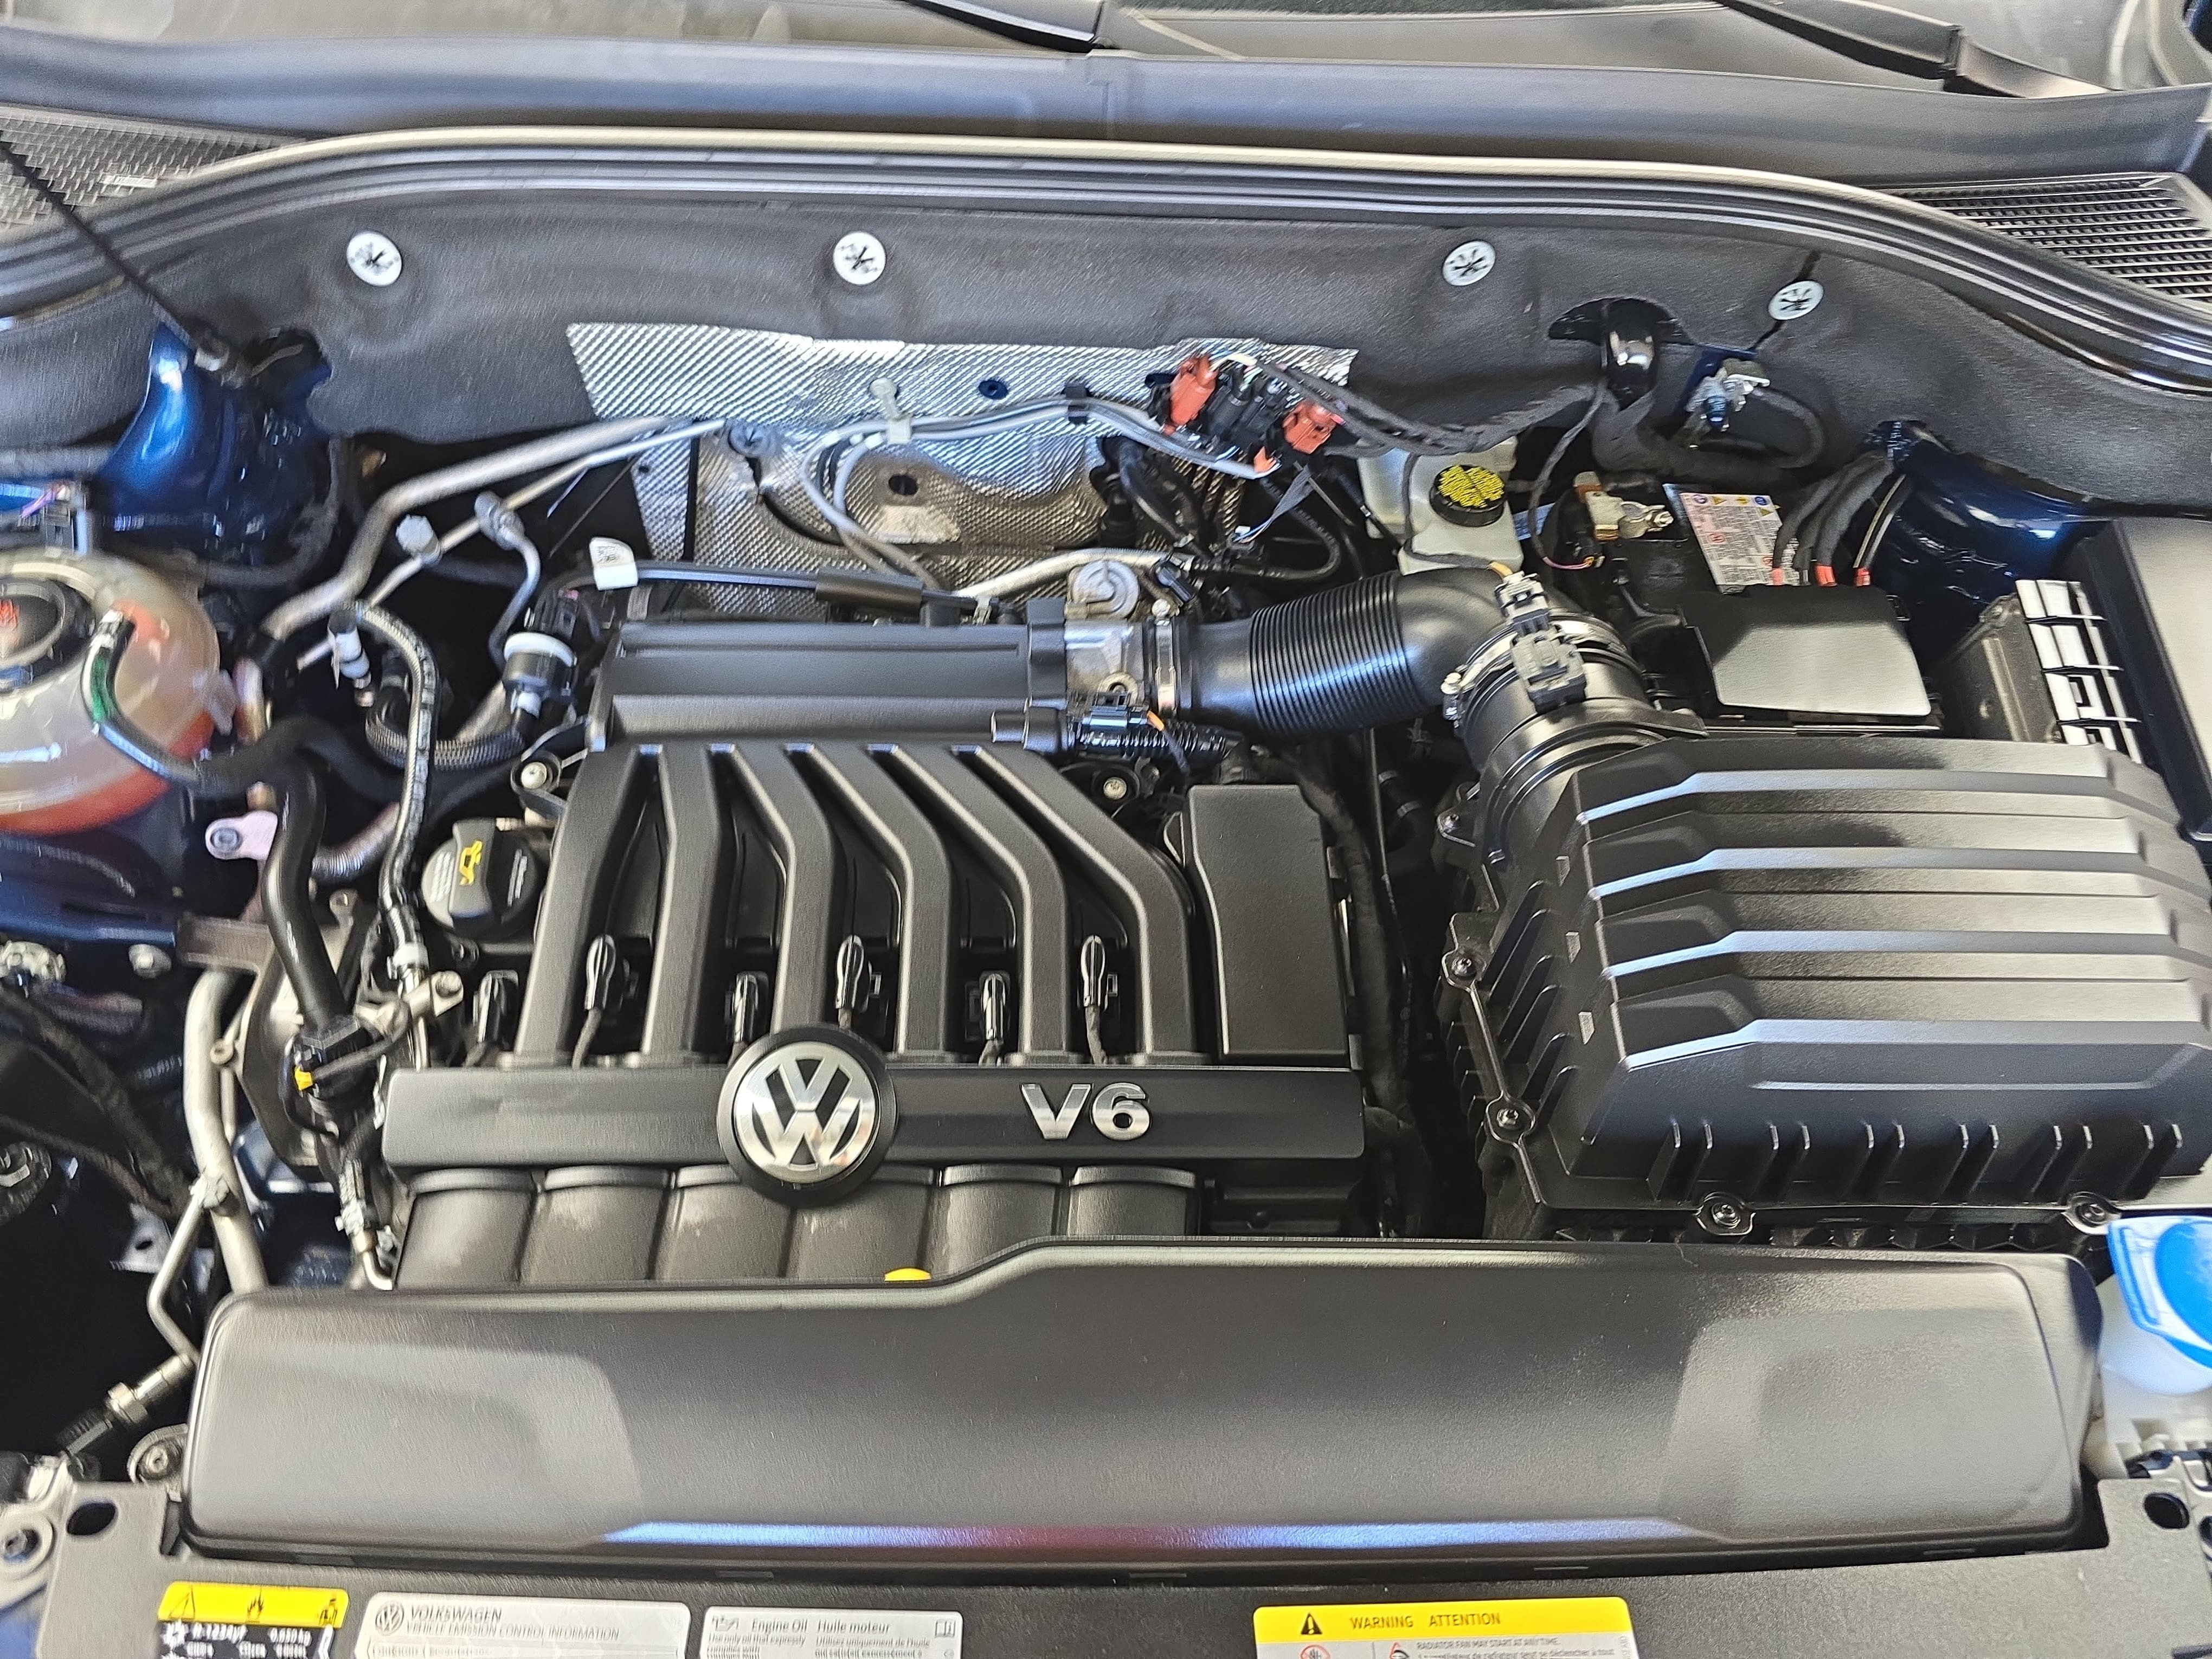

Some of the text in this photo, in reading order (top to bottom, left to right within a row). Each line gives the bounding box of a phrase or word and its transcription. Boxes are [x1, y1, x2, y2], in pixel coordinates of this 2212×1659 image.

[1020, 1083, 1151, 1140] V6
[410, 1604, 502, 1623] VOLKSWAGEN
[1350, 1612, 1501, 1629] WARNING ATTENTION
[448, 1623, 497, 1637] EMISSION
[500, 1624, 544, 1638] CONTROL
[548, 1625, 621, 1641] INFORMATION
[752, 1617, 808, 1635] Engine Oil
[818, 1619, 890, 1634] Huile moteur
[1416, 1640, 1455, 1649] RADIATOR
